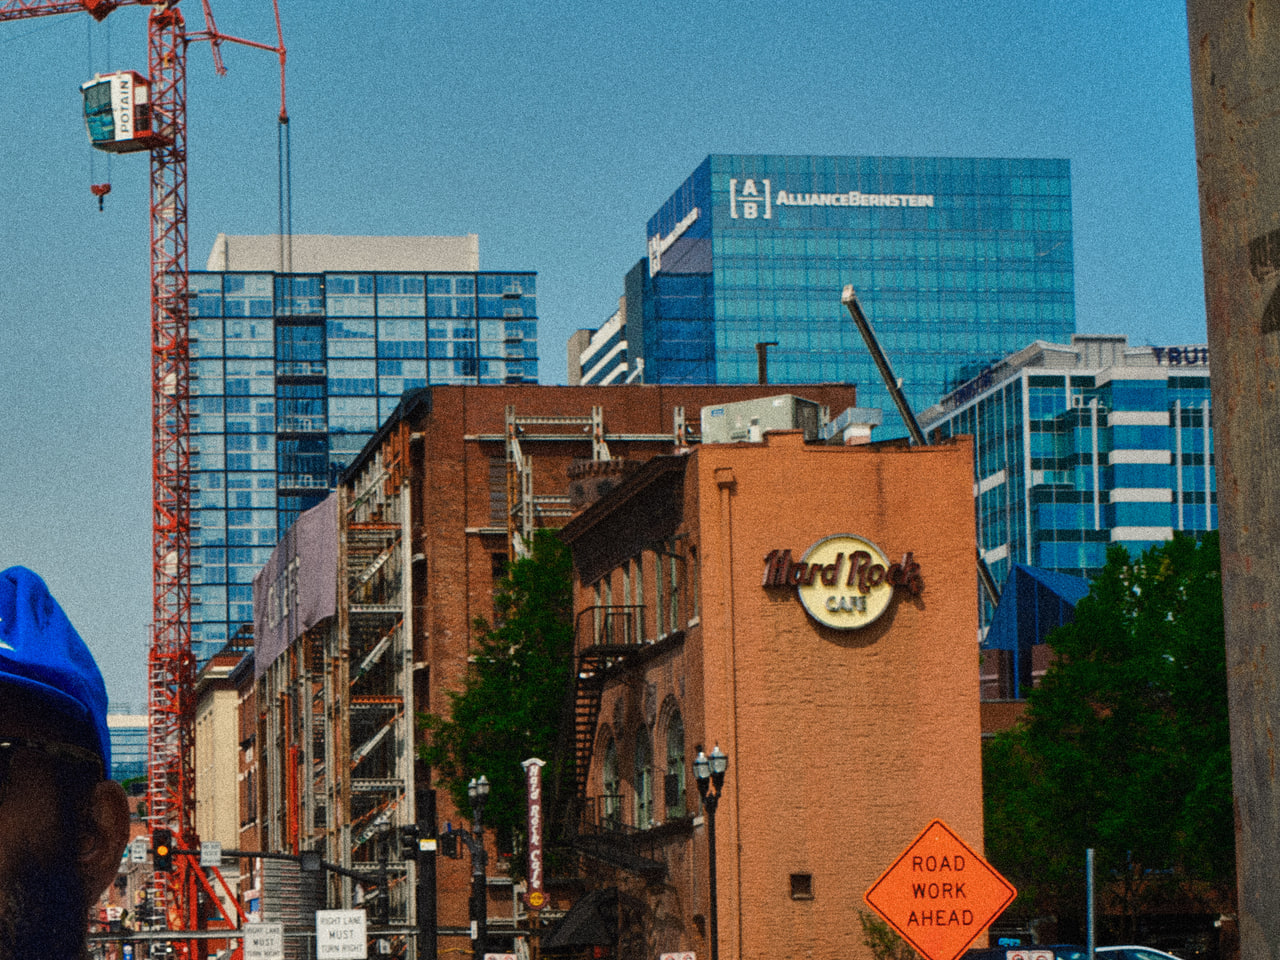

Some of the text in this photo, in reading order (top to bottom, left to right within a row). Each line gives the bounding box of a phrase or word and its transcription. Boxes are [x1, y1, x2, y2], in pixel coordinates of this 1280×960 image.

[120, 80, 130, 133] POTAIN
[1151, 347, 1208, 365] TRUI
[762, 549, 926, 595] Hard Rock
[825, 595, 867, 612] CAFE
[912, 855, 965, 872] ROAD
[912, 883, 966, 899] WORK
[907, 909, 974, 927] AHEAD
[253, 939, 274, 947] MUST
[329, 929, 354, 940] MUST
